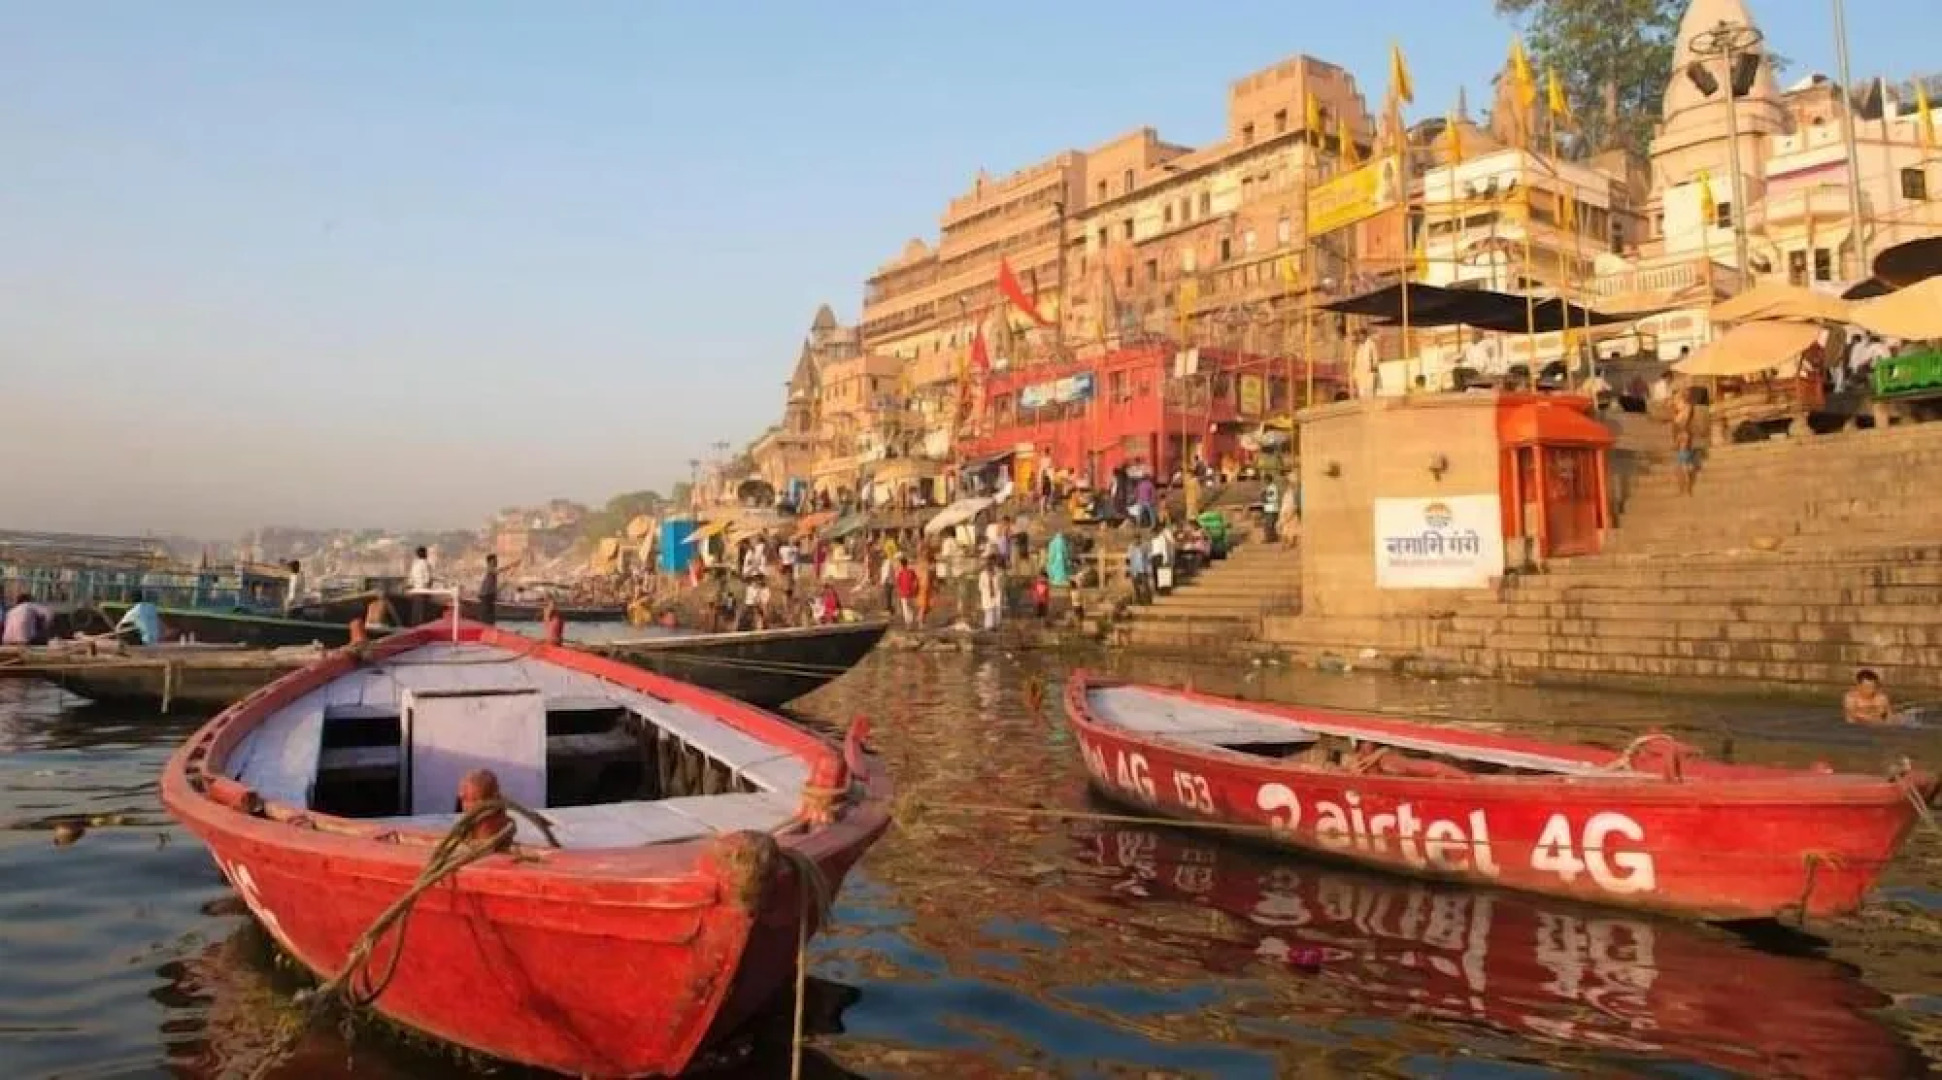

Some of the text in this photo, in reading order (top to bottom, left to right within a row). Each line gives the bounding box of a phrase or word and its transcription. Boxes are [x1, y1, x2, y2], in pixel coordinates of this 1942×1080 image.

[1117, 749, 1157, 803] 4G
[1173, 768, 1214, 815] 153
[1314, 789, 1657, 894] airtel 4G
